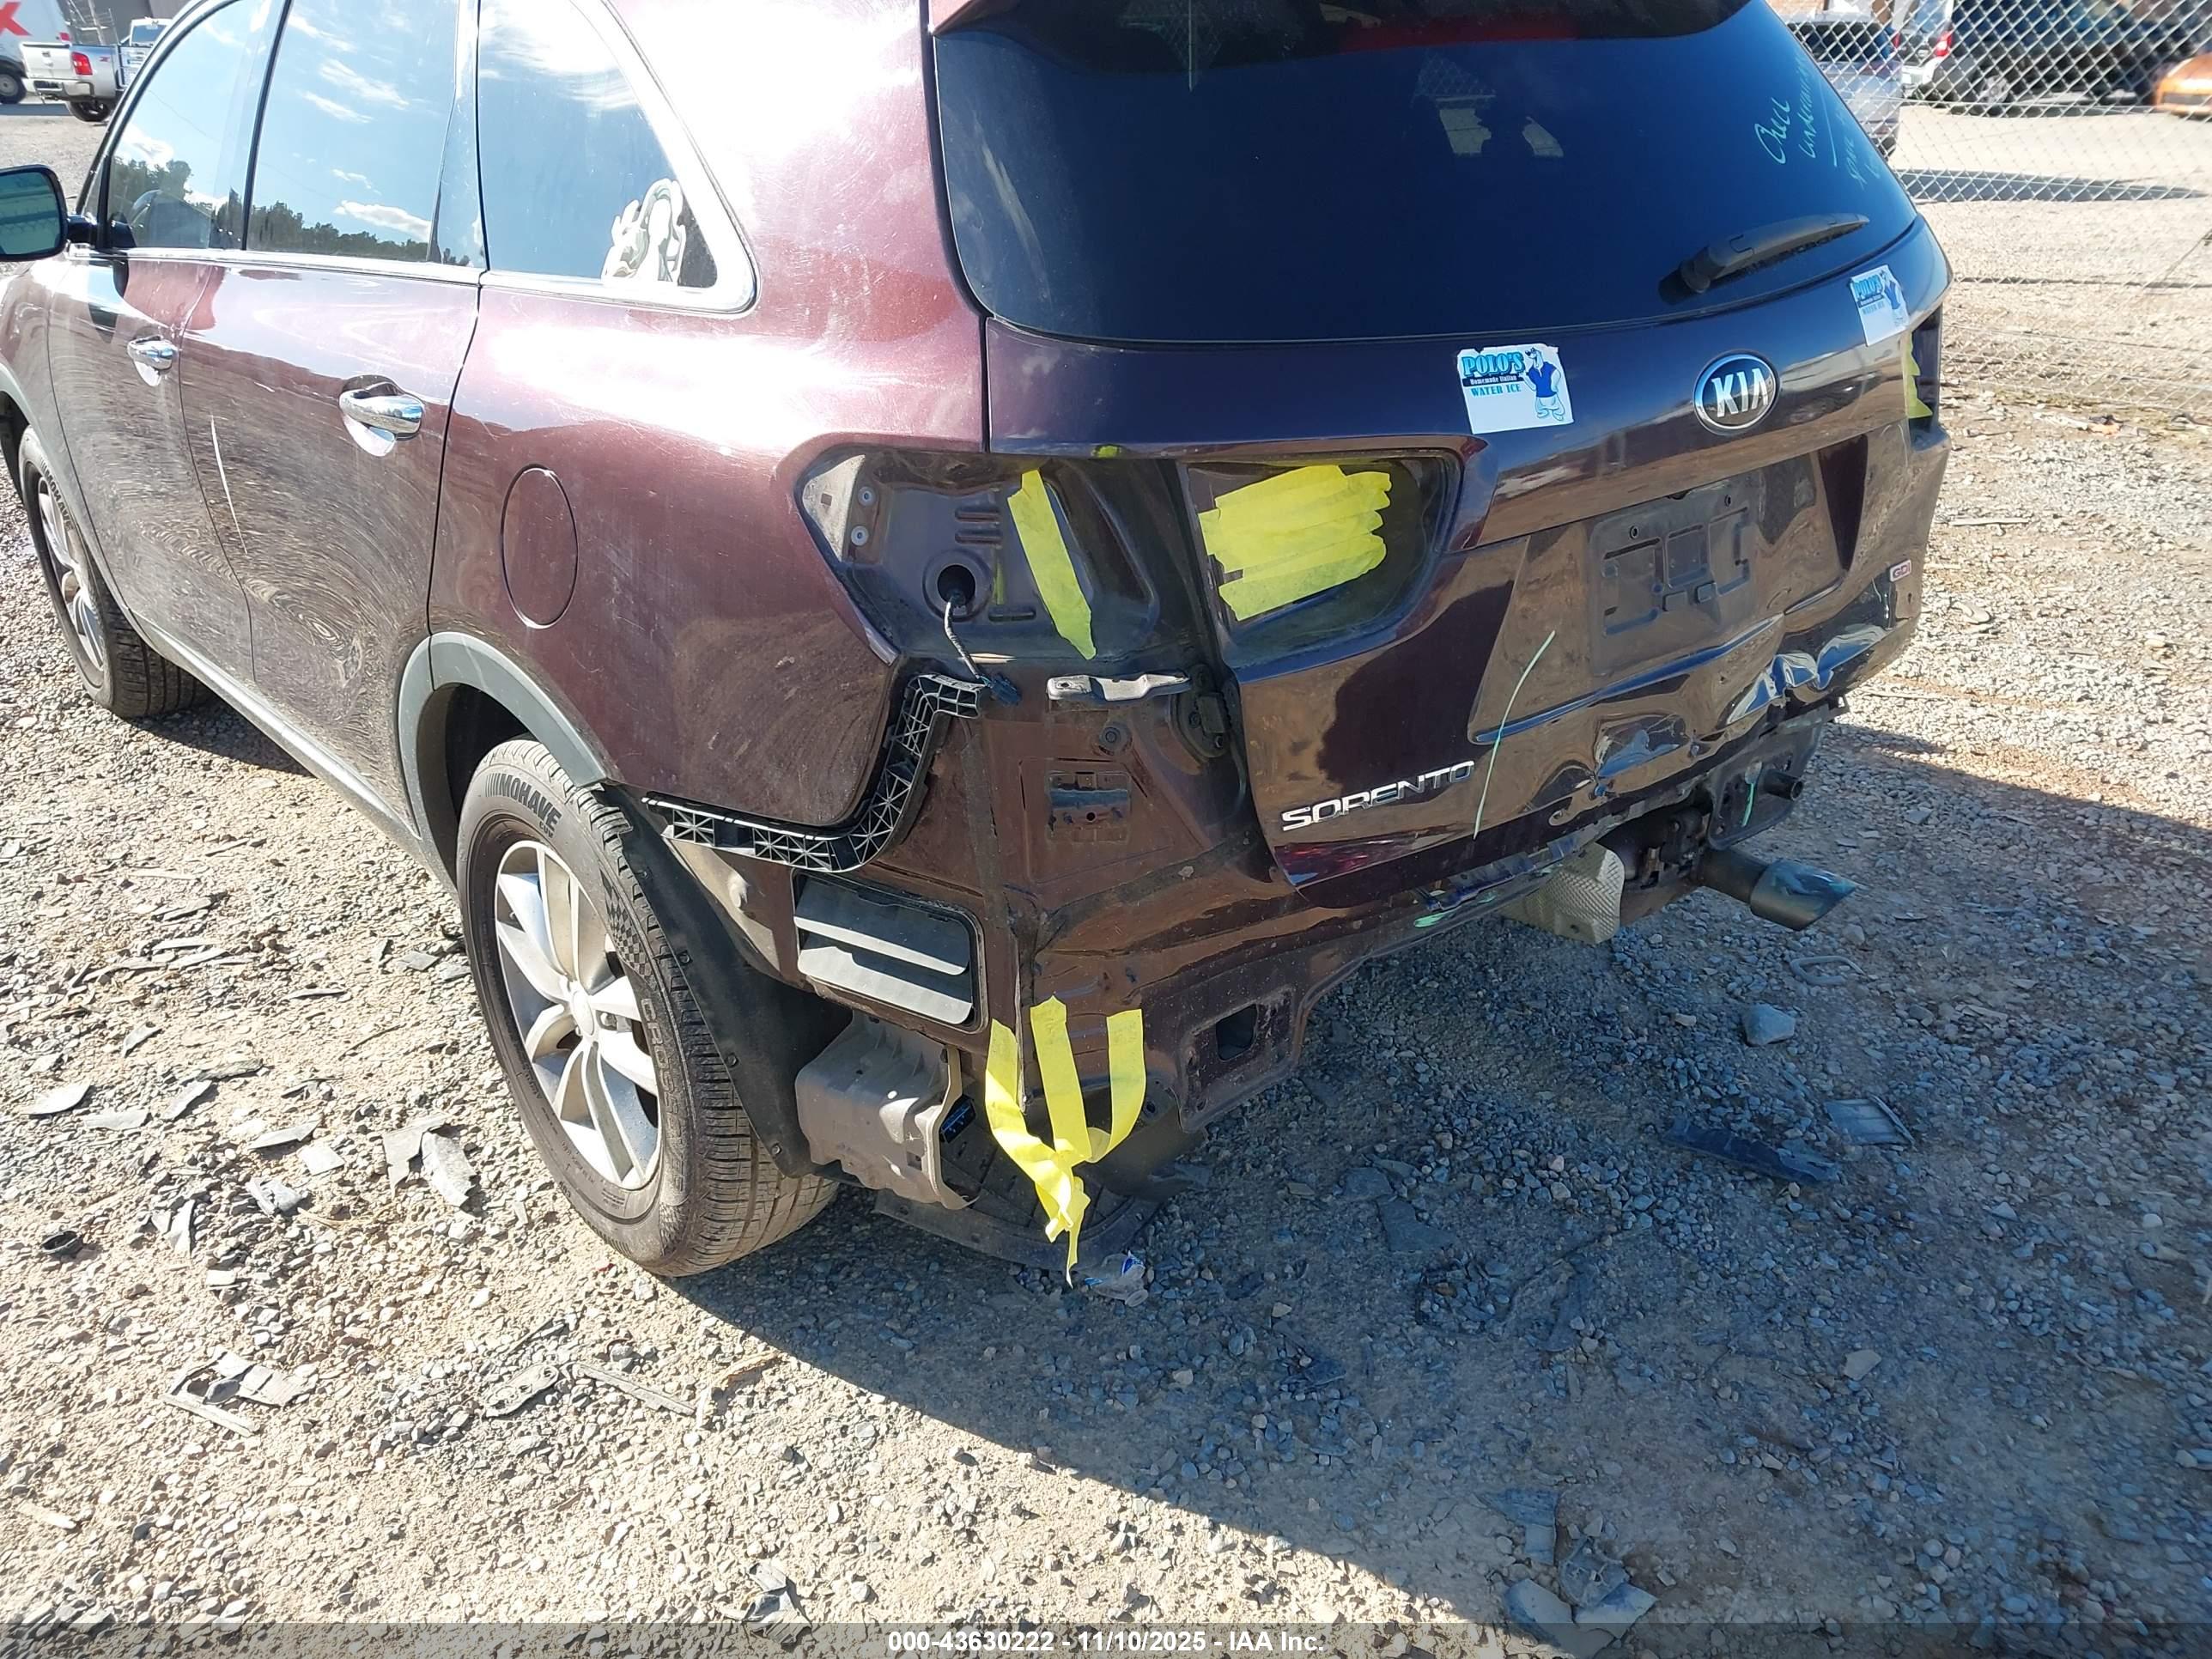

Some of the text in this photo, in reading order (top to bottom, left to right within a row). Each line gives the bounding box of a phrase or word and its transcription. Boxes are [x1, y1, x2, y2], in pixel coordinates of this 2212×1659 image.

[1462, 351, 1525, 376] POLO'S
[1471, 383, 1522, 396] WATER ICE
[1711, 368, 1769, 418] KIA
[499, 773, 562, 831] MOHAVE
[1282, 760, 1474, 831] SORENTO
